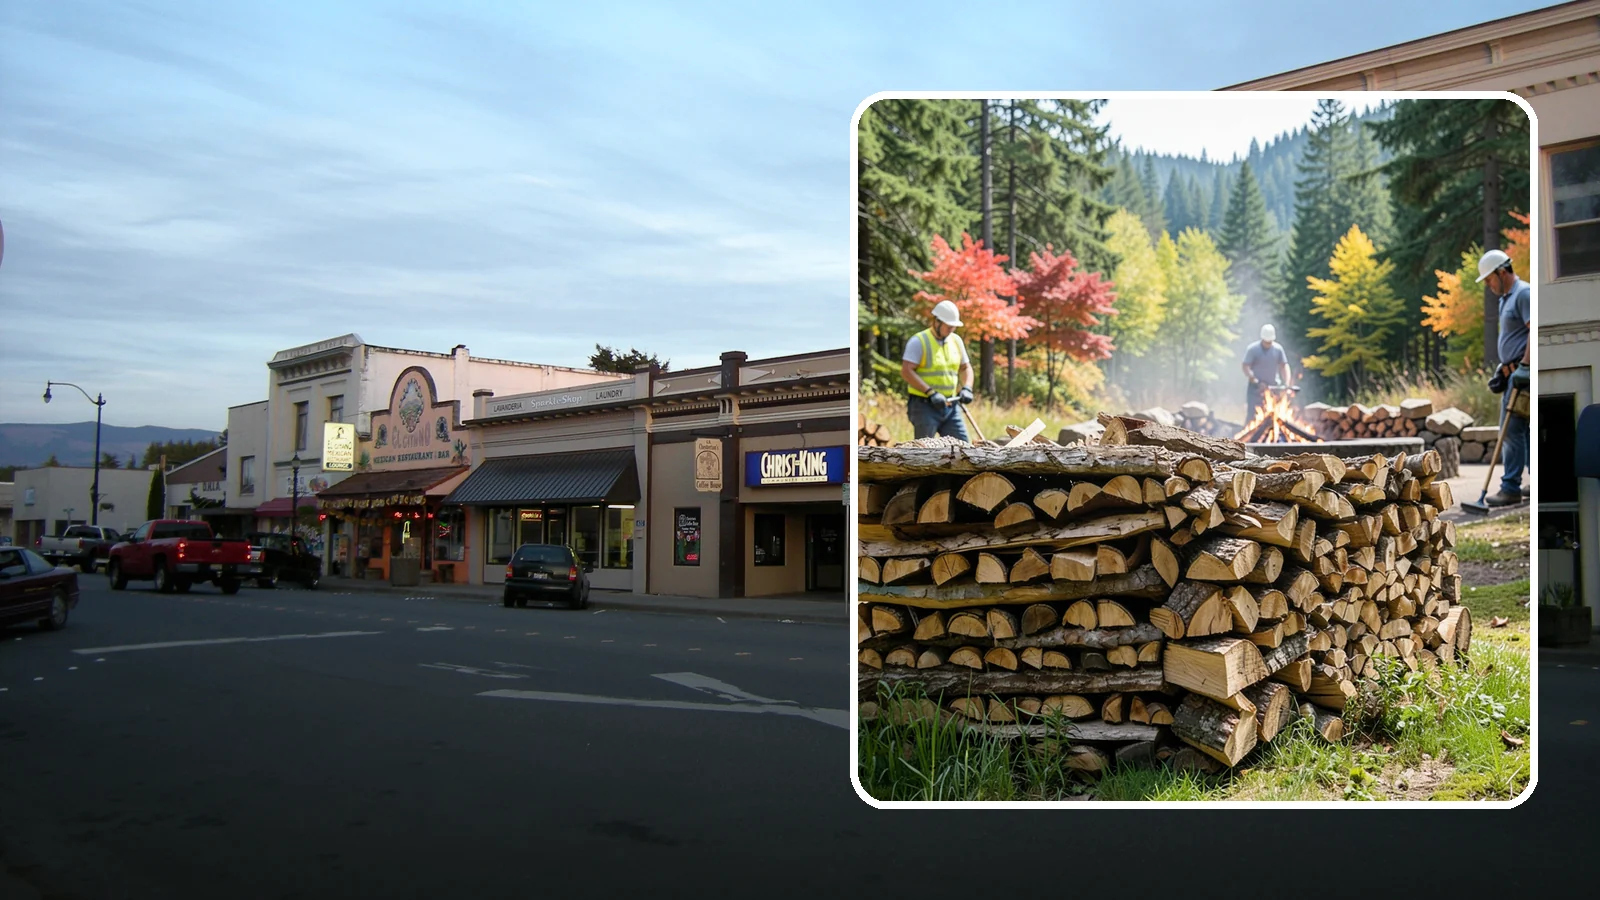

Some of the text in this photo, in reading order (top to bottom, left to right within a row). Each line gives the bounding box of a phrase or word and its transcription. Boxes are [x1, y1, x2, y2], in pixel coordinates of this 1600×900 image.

[595, 389, 623, 399] LAUNDRY
[493, 402, 522, 412] LAVANDERIA
[531, 395, 582, 408] Sparkle Shop
[373, 456, 396, 464] MEXICAN
[397, 452, 433, 462] RESTAURANT
[761, 450, 827, 477] CHRIST KING
